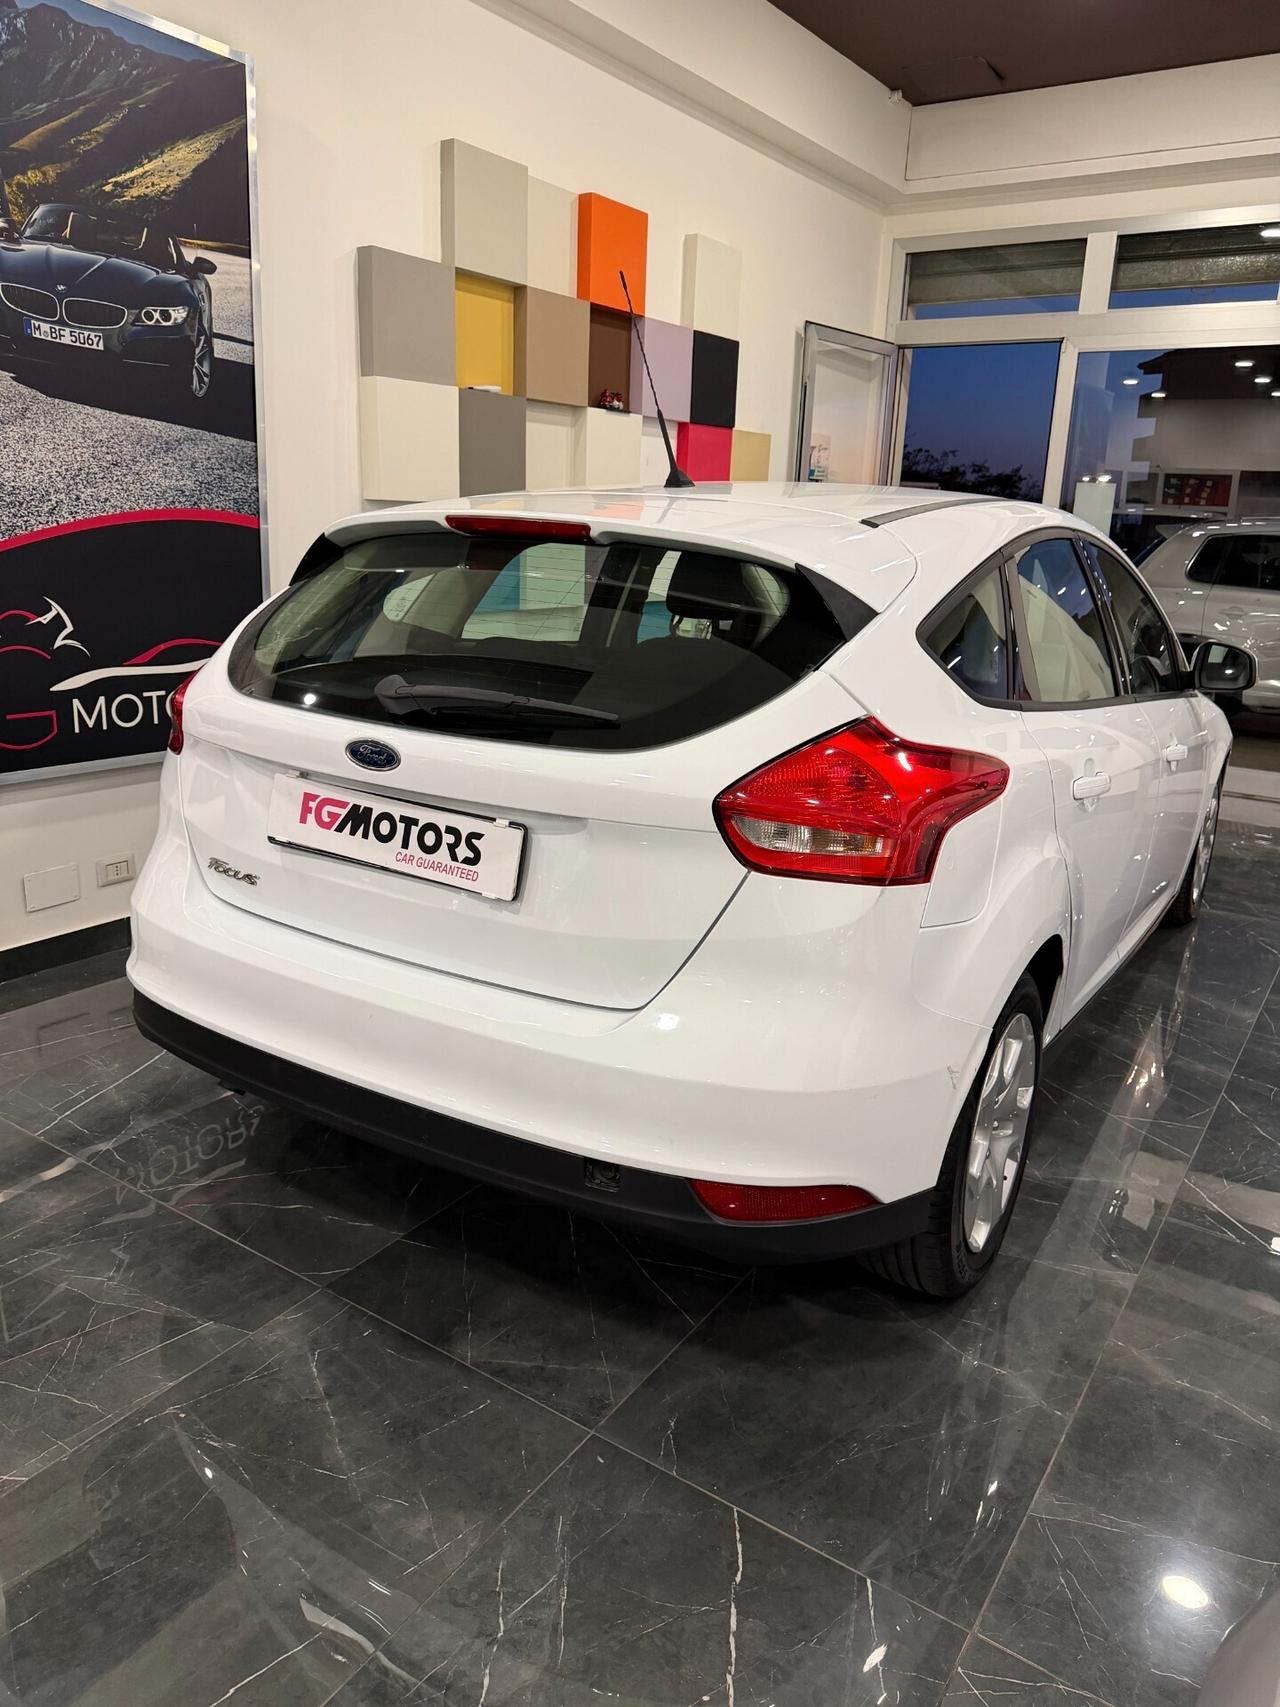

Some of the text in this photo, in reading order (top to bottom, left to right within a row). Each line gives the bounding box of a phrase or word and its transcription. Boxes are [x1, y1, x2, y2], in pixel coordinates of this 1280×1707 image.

[33, 323, 102, 348] M BF 5067
[72, 690, 173, 734] MOT
[395, 851, 479, 883] CAR GUARANTEED
